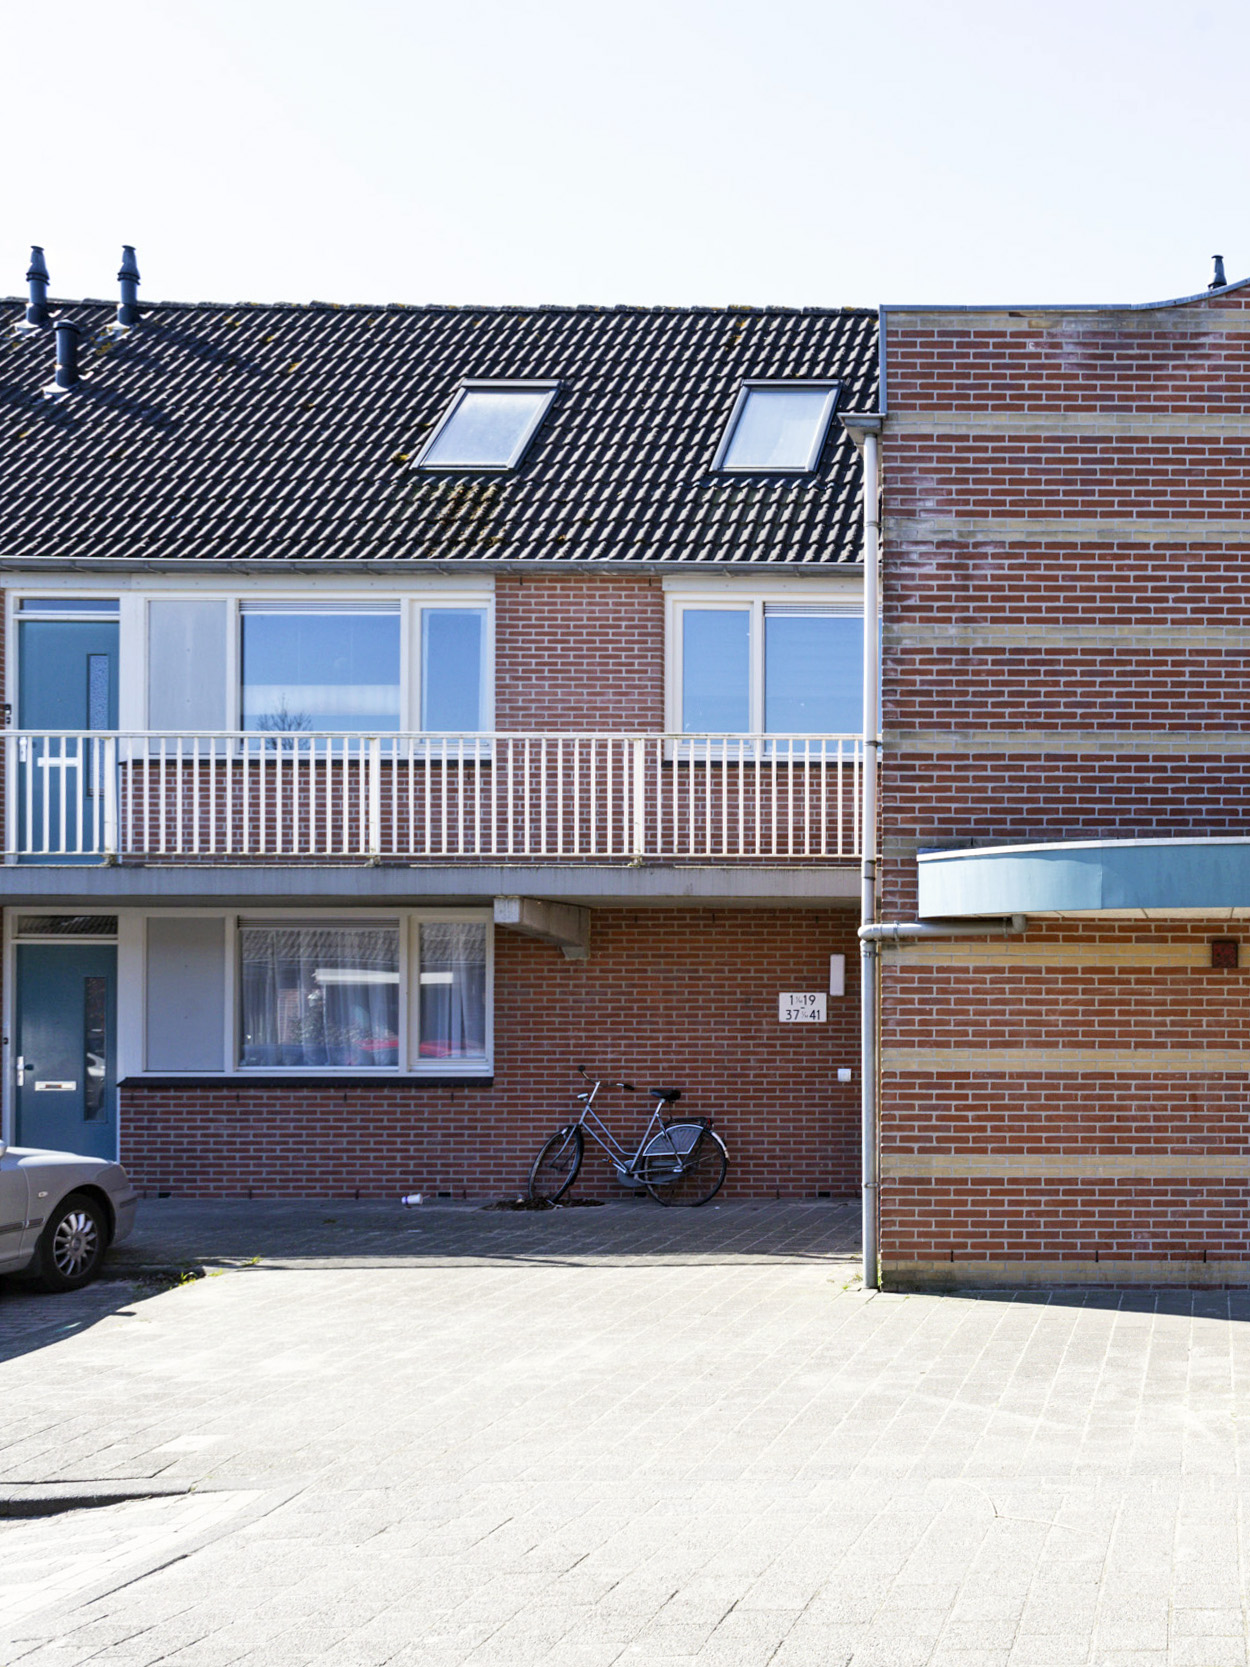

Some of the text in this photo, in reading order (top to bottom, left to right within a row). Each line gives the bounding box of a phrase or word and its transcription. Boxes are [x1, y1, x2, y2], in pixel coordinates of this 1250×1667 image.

[803, 994, 816, 1005] 19
[785, 1009, 800, 1020] 37
[809, 1009, 820, 1020] 41
